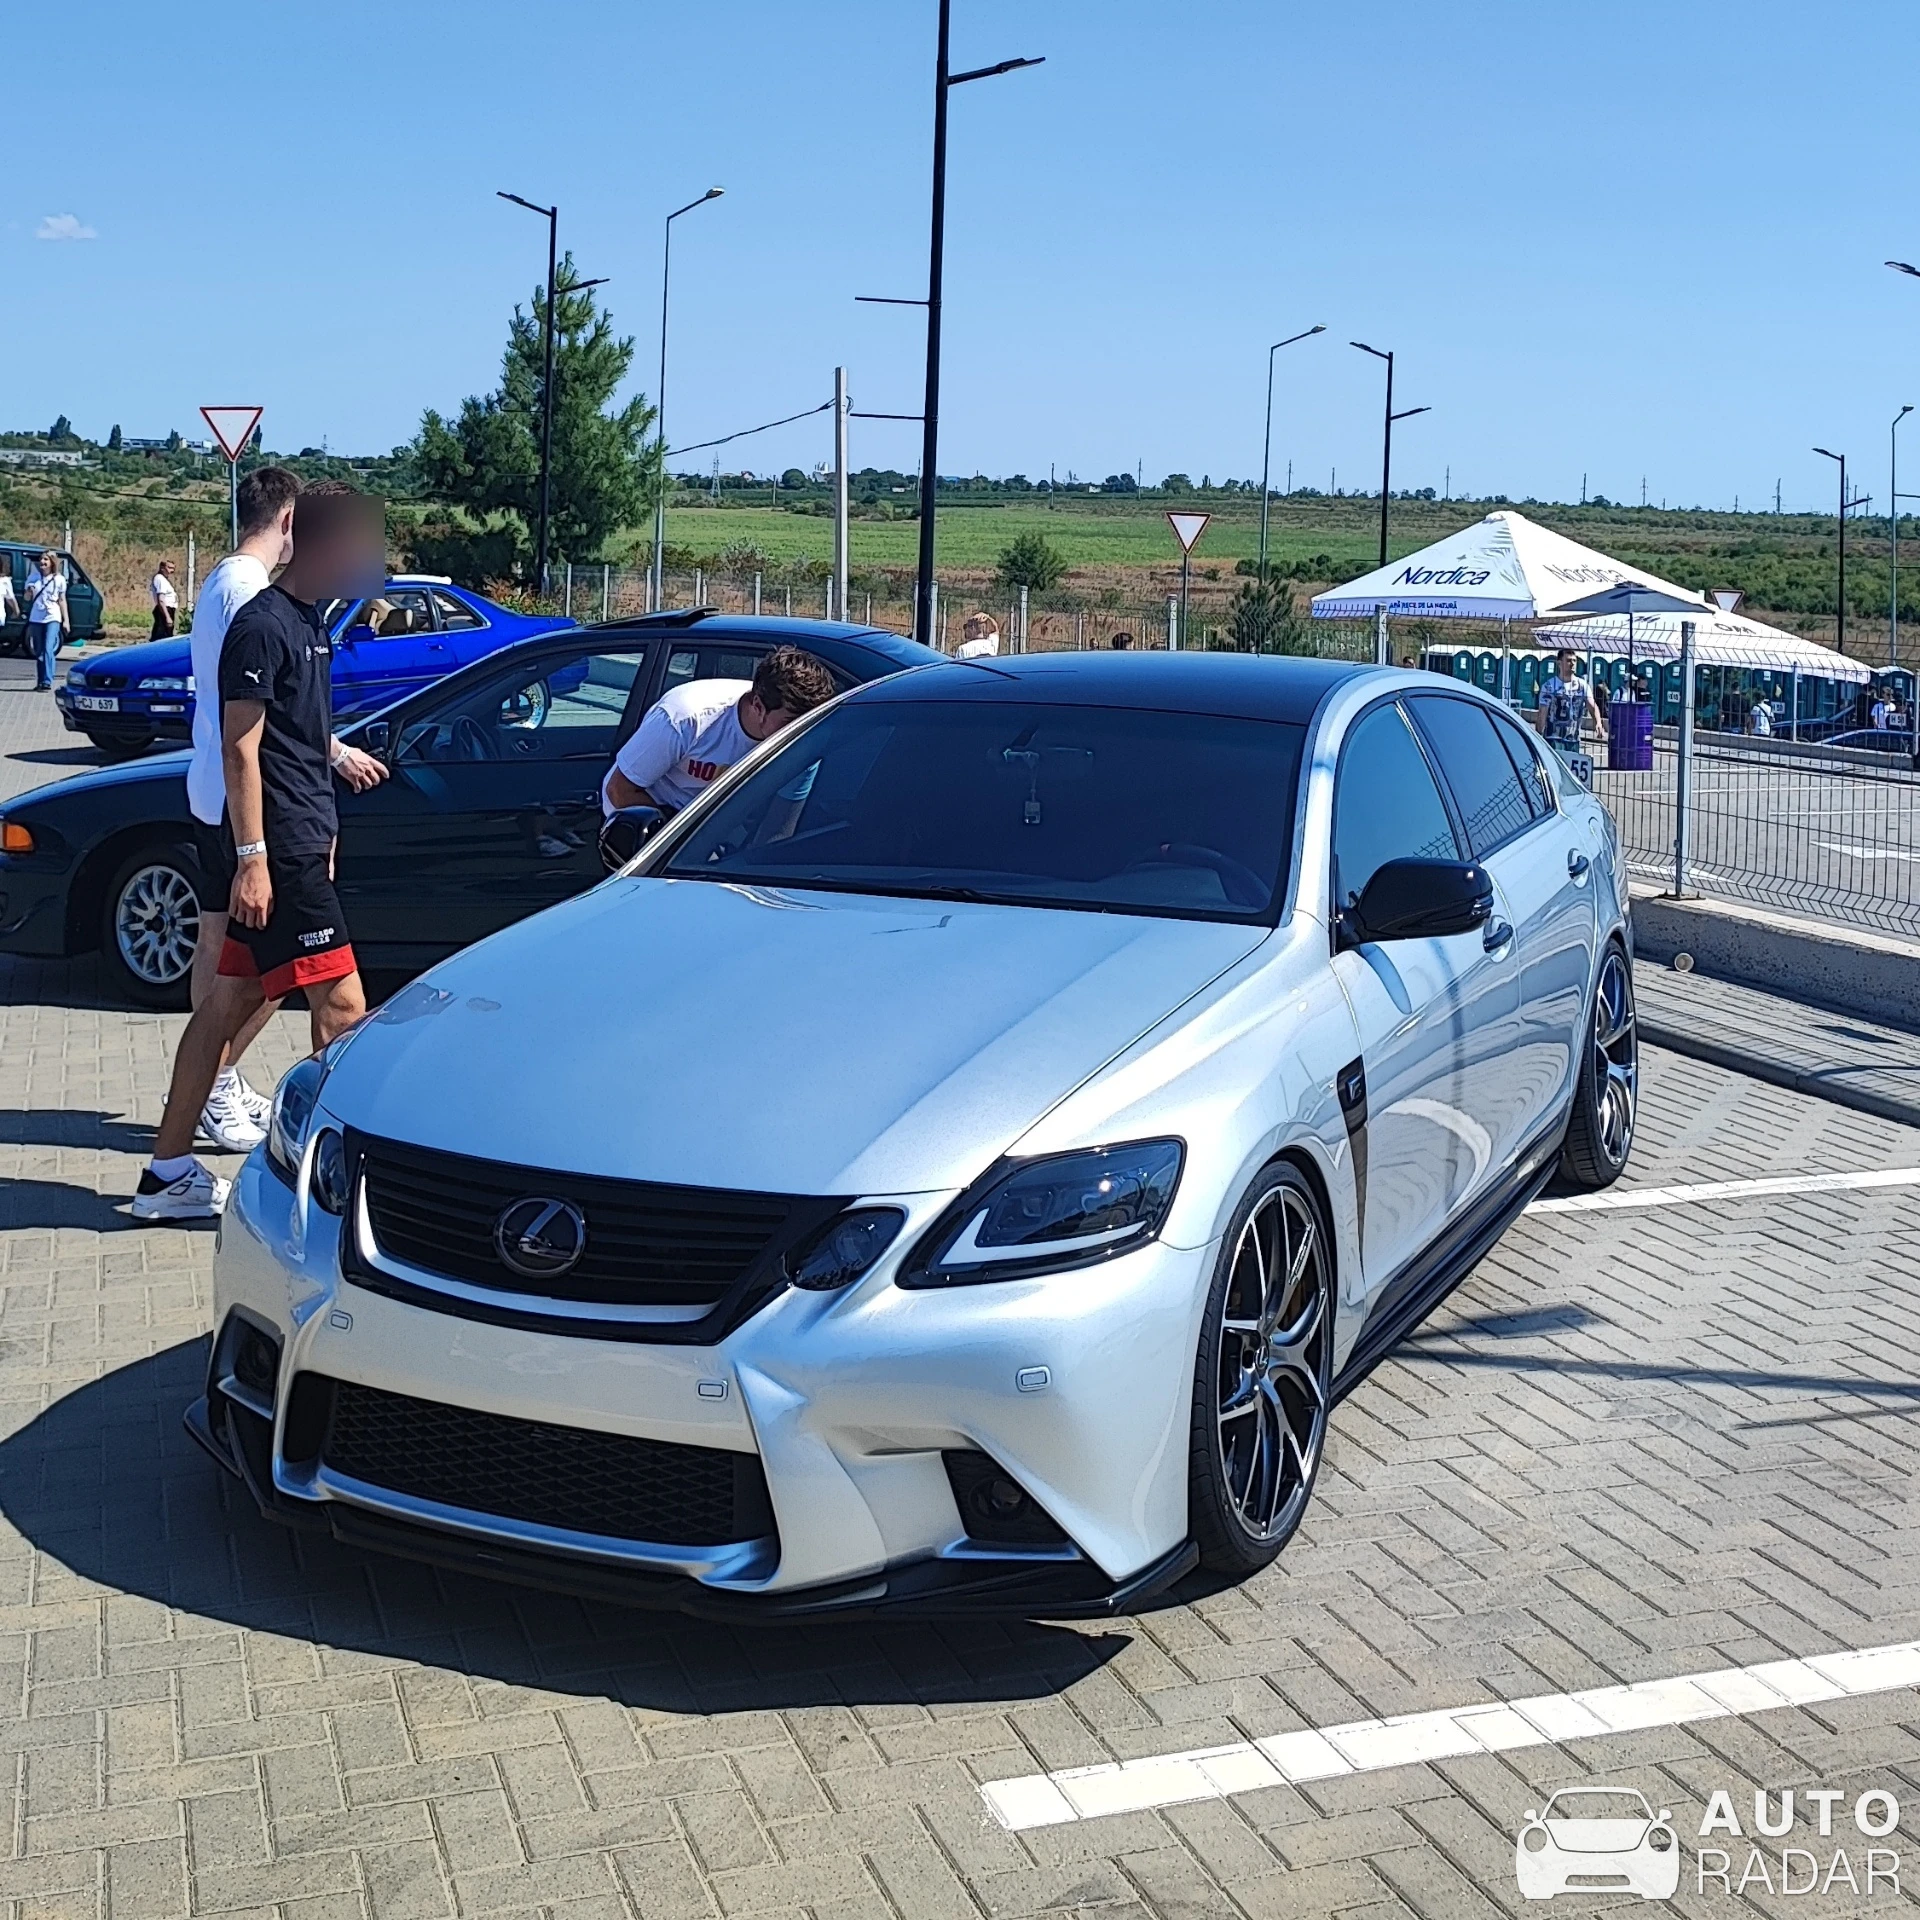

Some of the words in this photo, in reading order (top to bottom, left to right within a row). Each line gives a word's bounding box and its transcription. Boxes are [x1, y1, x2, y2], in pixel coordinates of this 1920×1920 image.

[1391, 566, 1491, 586] Nordica
[1542, 564, 1627, 583] Nordica
[1571, 759, 1588, 782] 55
[298, 927, 334, 941] CHICAGO
